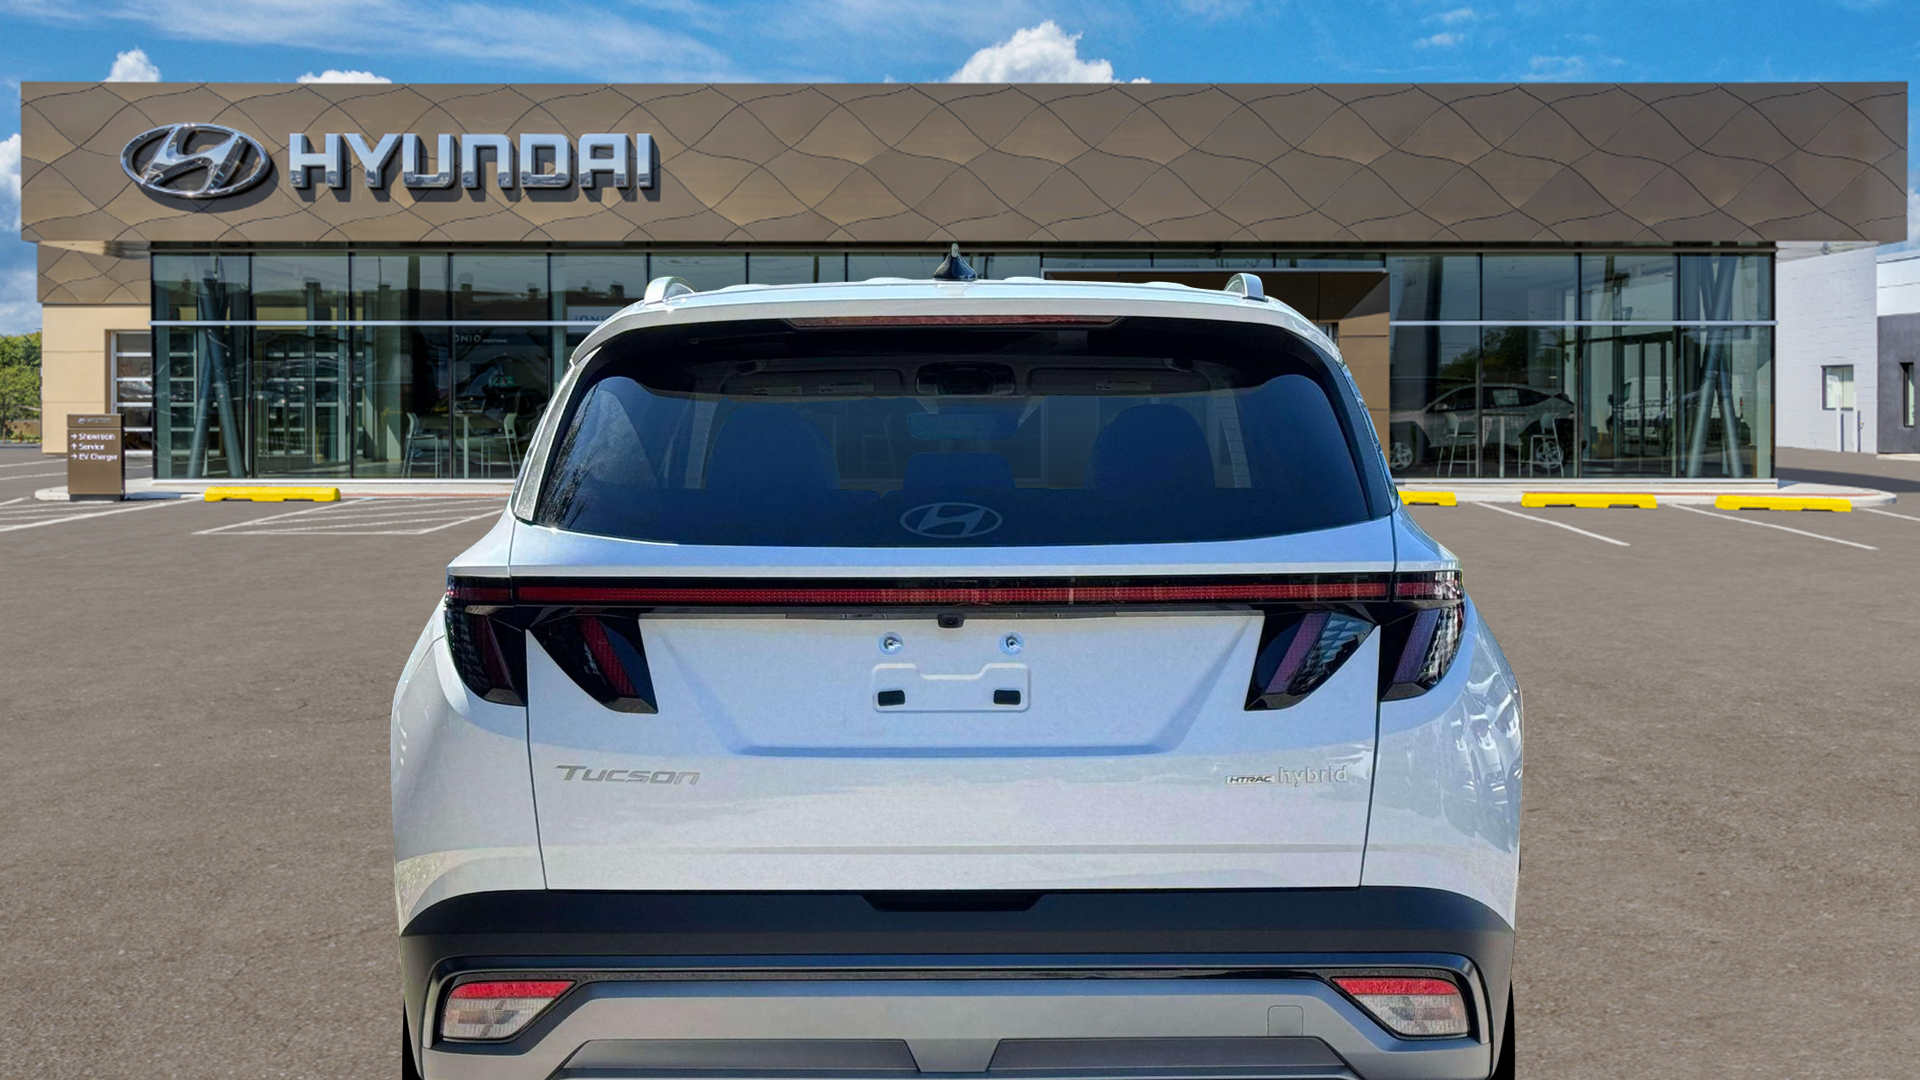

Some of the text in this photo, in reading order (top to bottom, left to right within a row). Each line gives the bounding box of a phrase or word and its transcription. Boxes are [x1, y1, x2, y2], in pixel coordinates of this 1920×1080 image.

[289, 133, 654, 189] HYUNDAI
[78, 433, 116, 441] Showroom
[78, 443, 105, 451] Service
[90, 453, 118, 462] Charger
[1229, 765, 1348, 788] HTRAC hybrid
